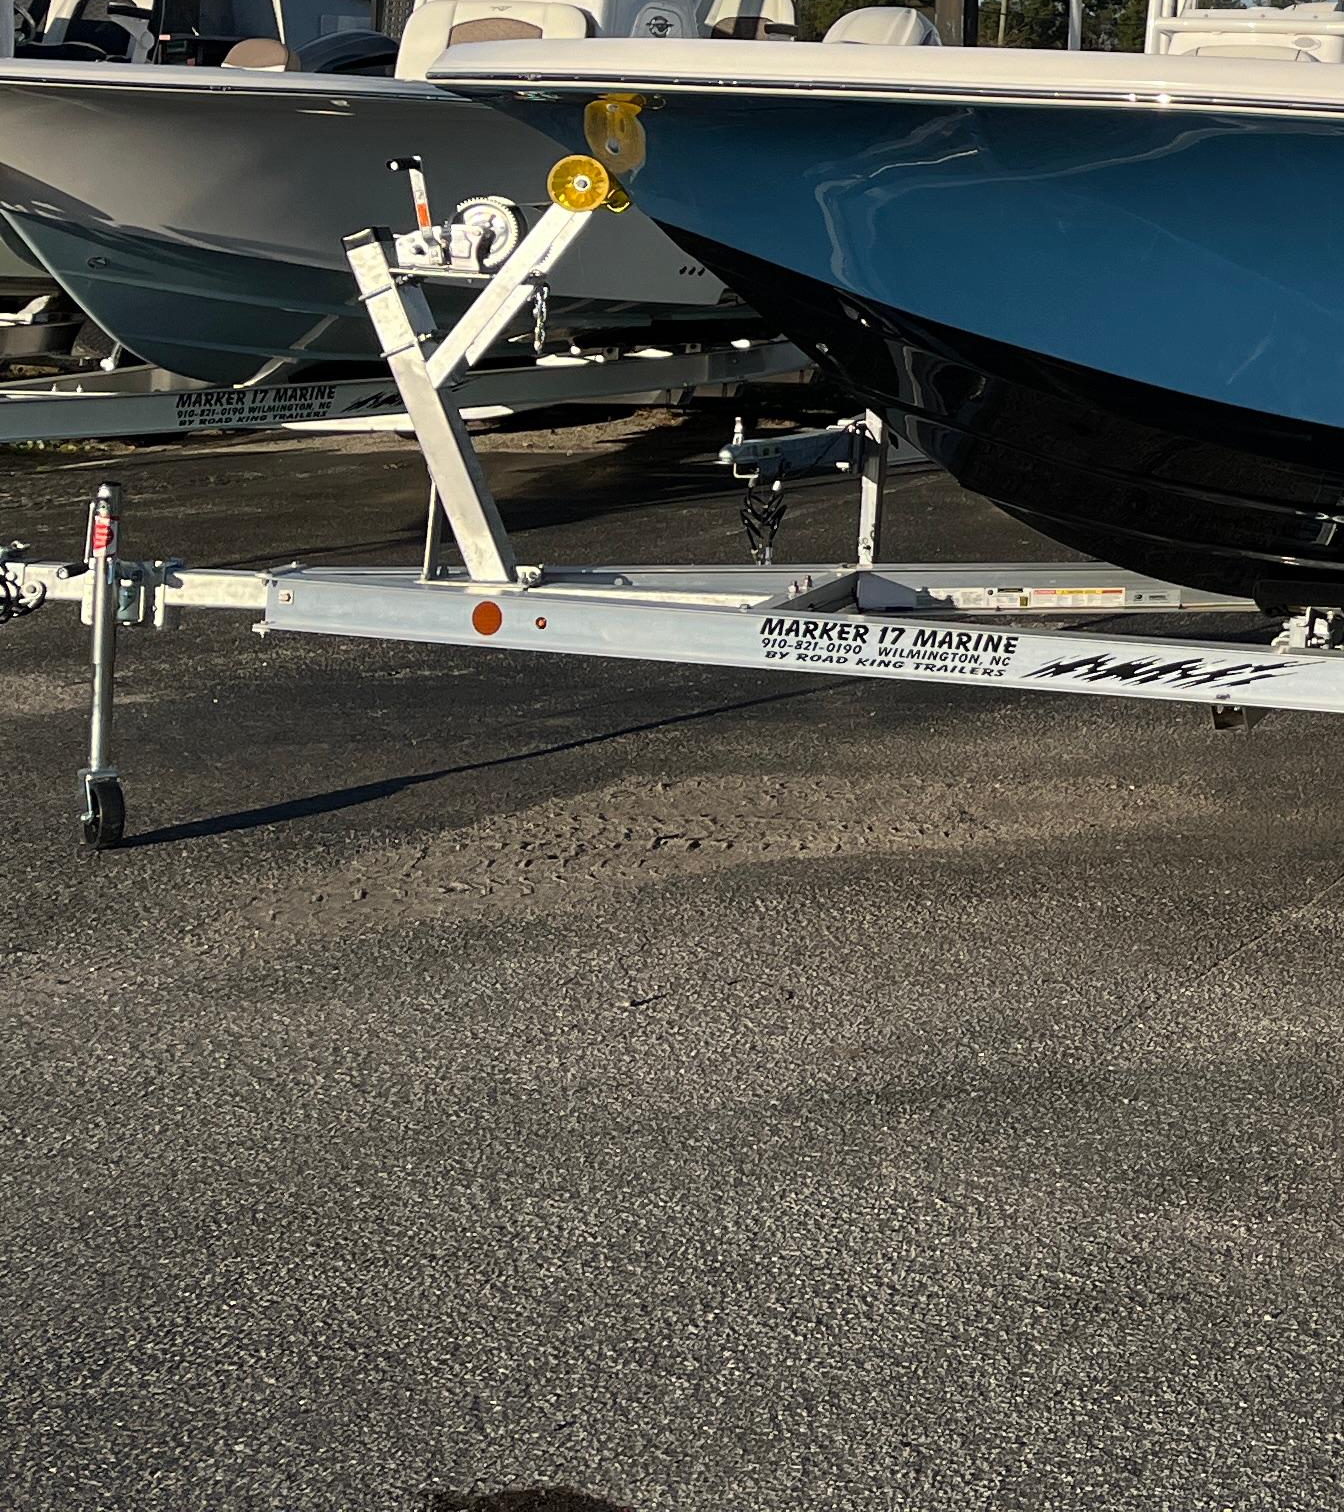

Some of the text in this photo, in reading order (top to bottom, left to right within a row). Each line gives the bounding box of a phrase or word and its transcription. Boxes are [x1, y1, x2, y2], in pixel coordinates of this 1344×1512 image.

[174, 385, 336, 409] MARKER 17 MARINE
[177, 405, 245, 419] 910-821-0190
[198, 416, 233, 426] ROAD
[236, 414, 268, 424] KING
[760, 617, 1019, 654] MARKER 17 MARINE
[761, 637, 1012, 667] 910-821-0190 WILMINGTON, NC
[764, 650, 1007, 678] BY ROAD KING TRAILERS
